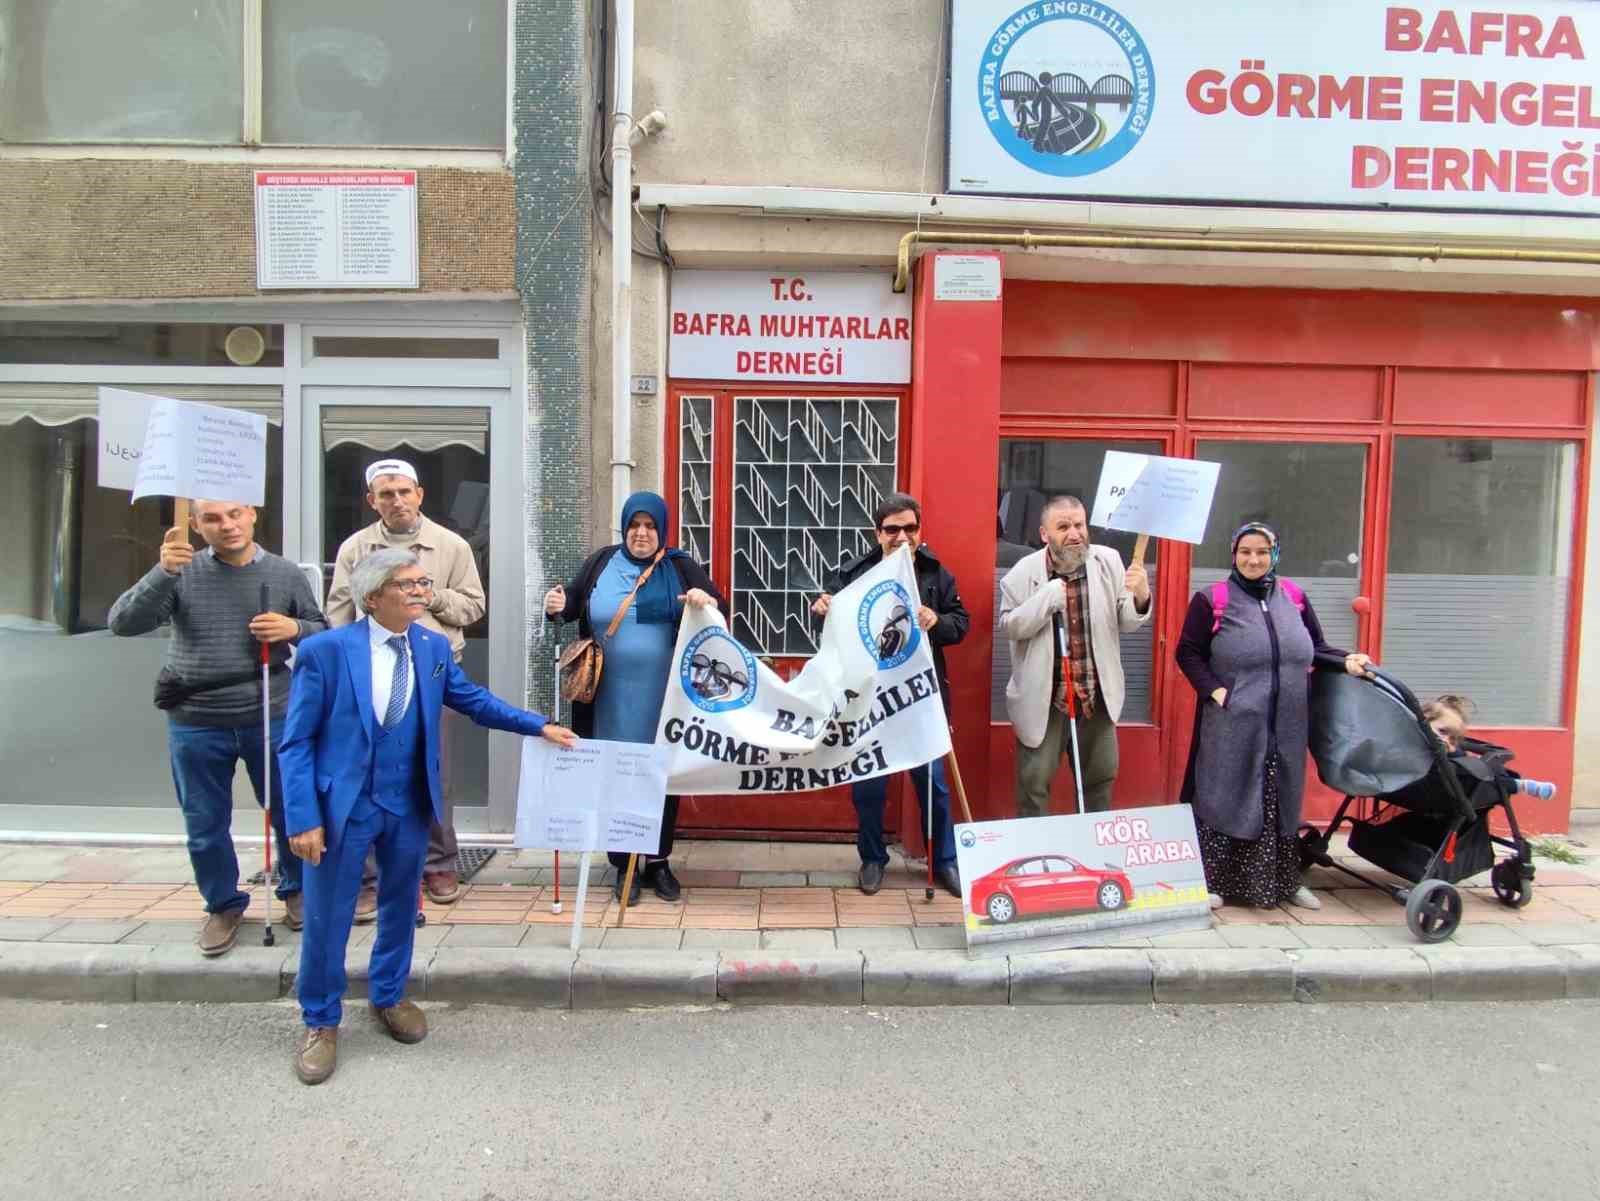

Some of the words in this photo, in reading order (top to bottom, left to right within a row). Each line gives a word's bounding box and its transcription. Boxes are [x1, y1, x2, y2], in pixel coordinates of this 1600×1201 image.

[1384, 7, 1585, 60] BAFRA
[983, 61, 1000, 121] BAFRA
[992, 8, 1041, 56] GÖRME
[1042, 2, 1137, 51] ENGELLİLER
[1186, 59, 1404, 122] GÖRME
[1419, 78, 1600, 129] ENGEL
[770, 278, 813, 301] T.C.
[673, 312, 751, 336] BAFRA
[760, 315, 910, 340] MUHTARLAR
[736, 347, 842, 376] DERNEĞİ
[664, 716, 770, 766] GÖRME
[738, 740, 888, 791] DERNEĞİ
[1095, 816, 1152, 845] KÖR
[1125, 840, 1198, 867] ARABA
